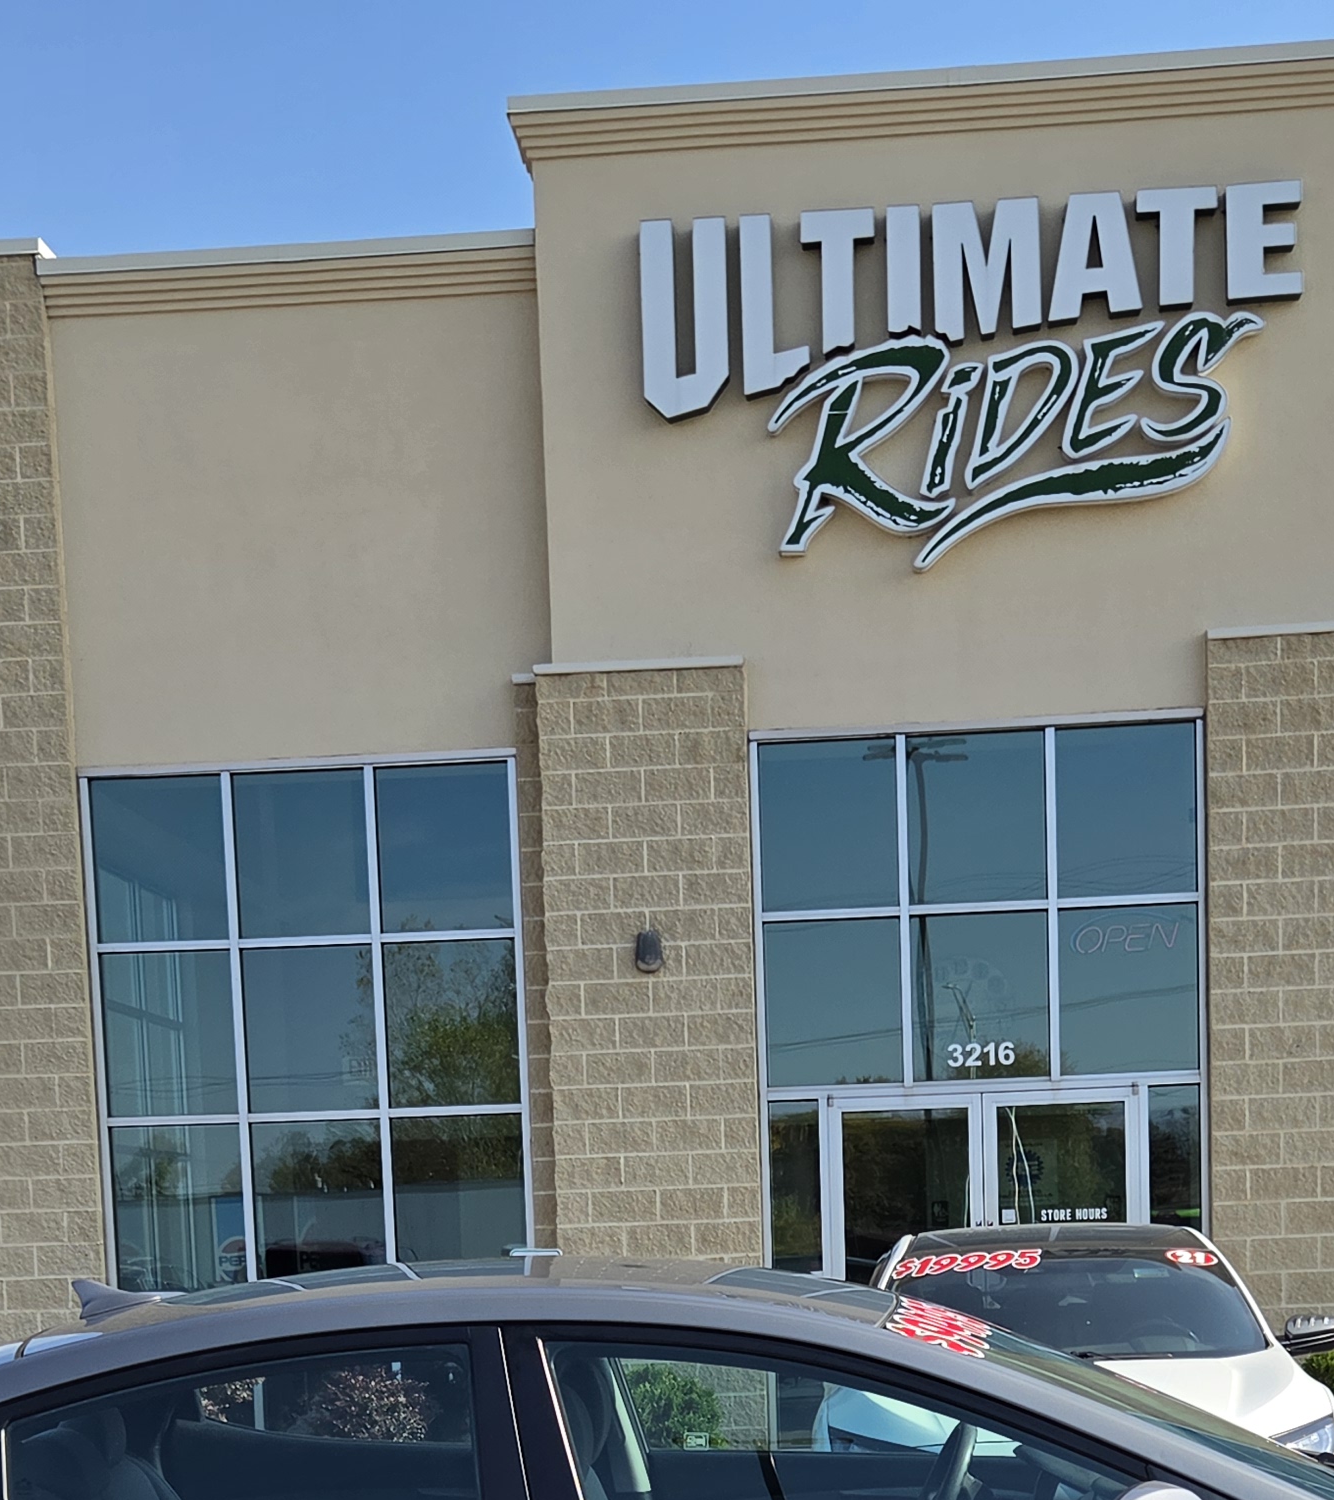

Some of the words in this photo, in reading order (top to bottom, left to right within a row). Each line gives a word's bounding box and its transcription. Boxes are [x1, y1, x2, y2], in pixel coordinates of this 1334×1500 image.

[639, 179, 1304, 424] ULTIMATE
[1075, 922, 1179, 954] OPEN
[947, 1041, 1015, 1067] 3216
[1041, 1209, 1072, 1221] STORE
[1076, 1208, 1108, 1220] HOURS
[892, 1248, 1042, 1279] $19995
[1174, 1249, 1206, 1264] 21
